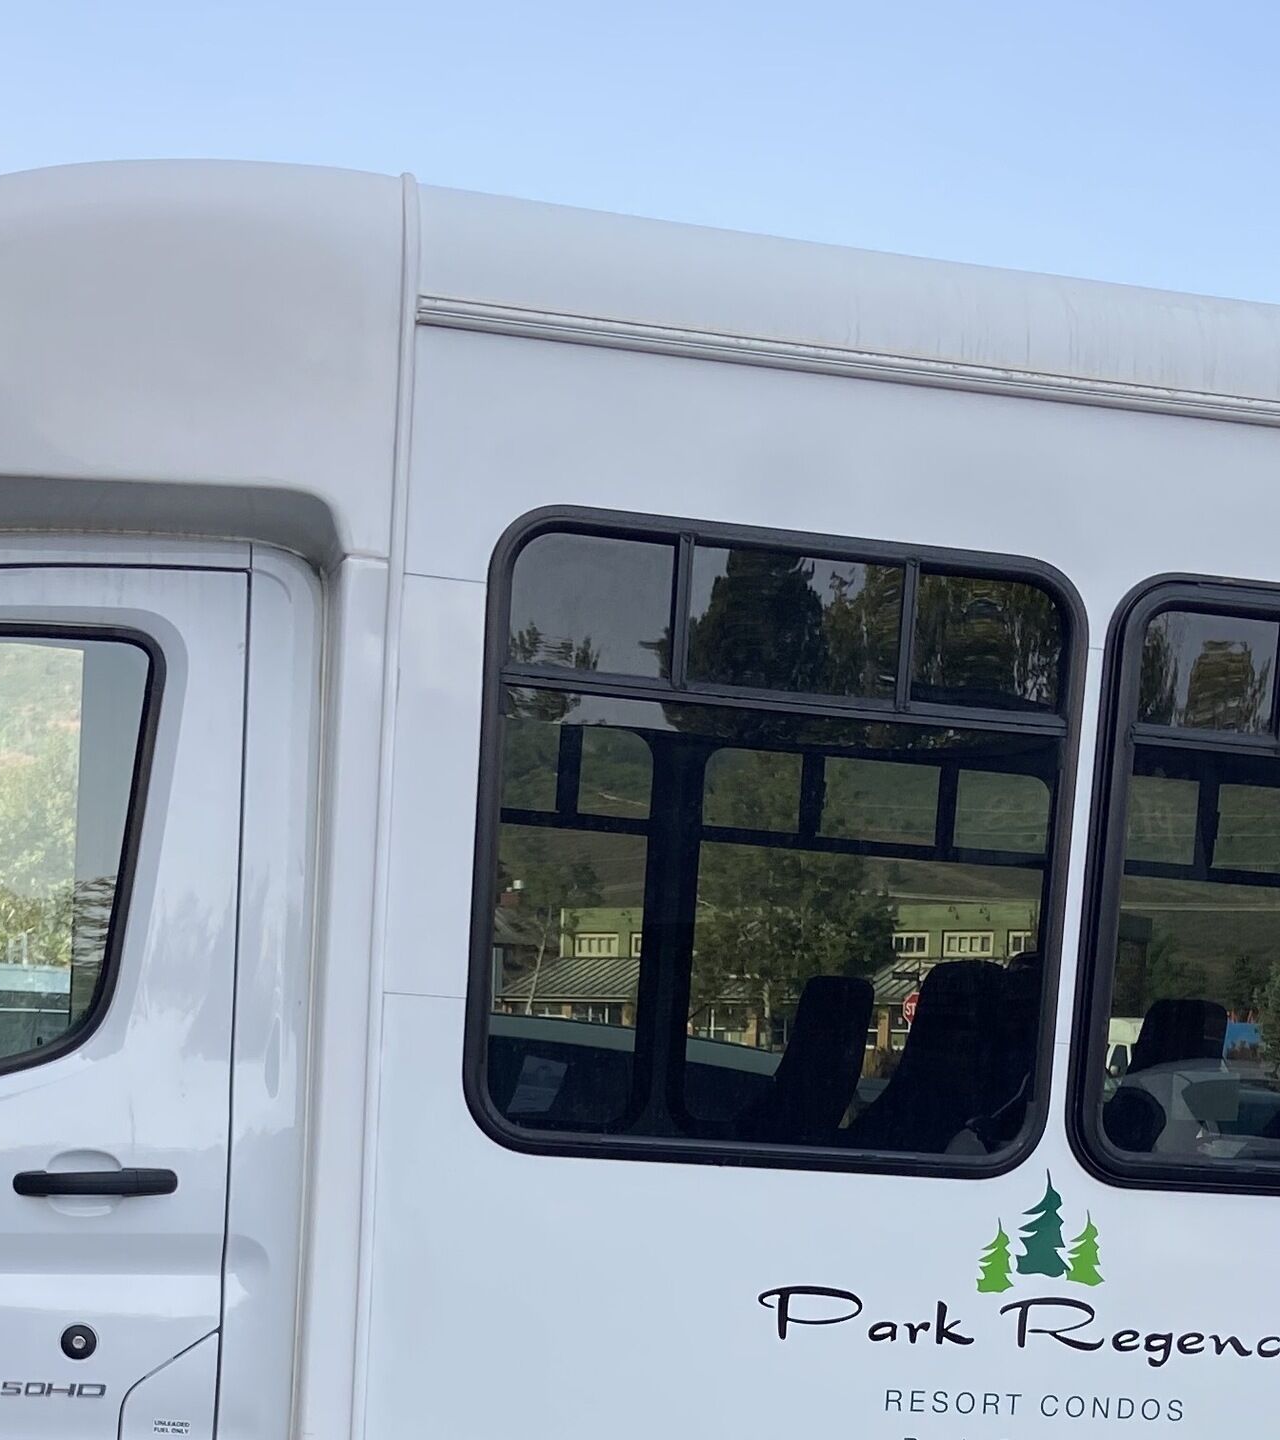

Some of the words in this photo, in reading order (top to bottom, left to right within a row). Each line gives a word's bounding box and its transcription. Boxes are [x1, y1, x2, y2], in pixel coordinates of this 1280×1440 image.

[757, 1284, 975, 1346] Park
[884, 1388, 1023, 1417] RESORT
[1039, 1393, 1185, 1423] CONDOS
